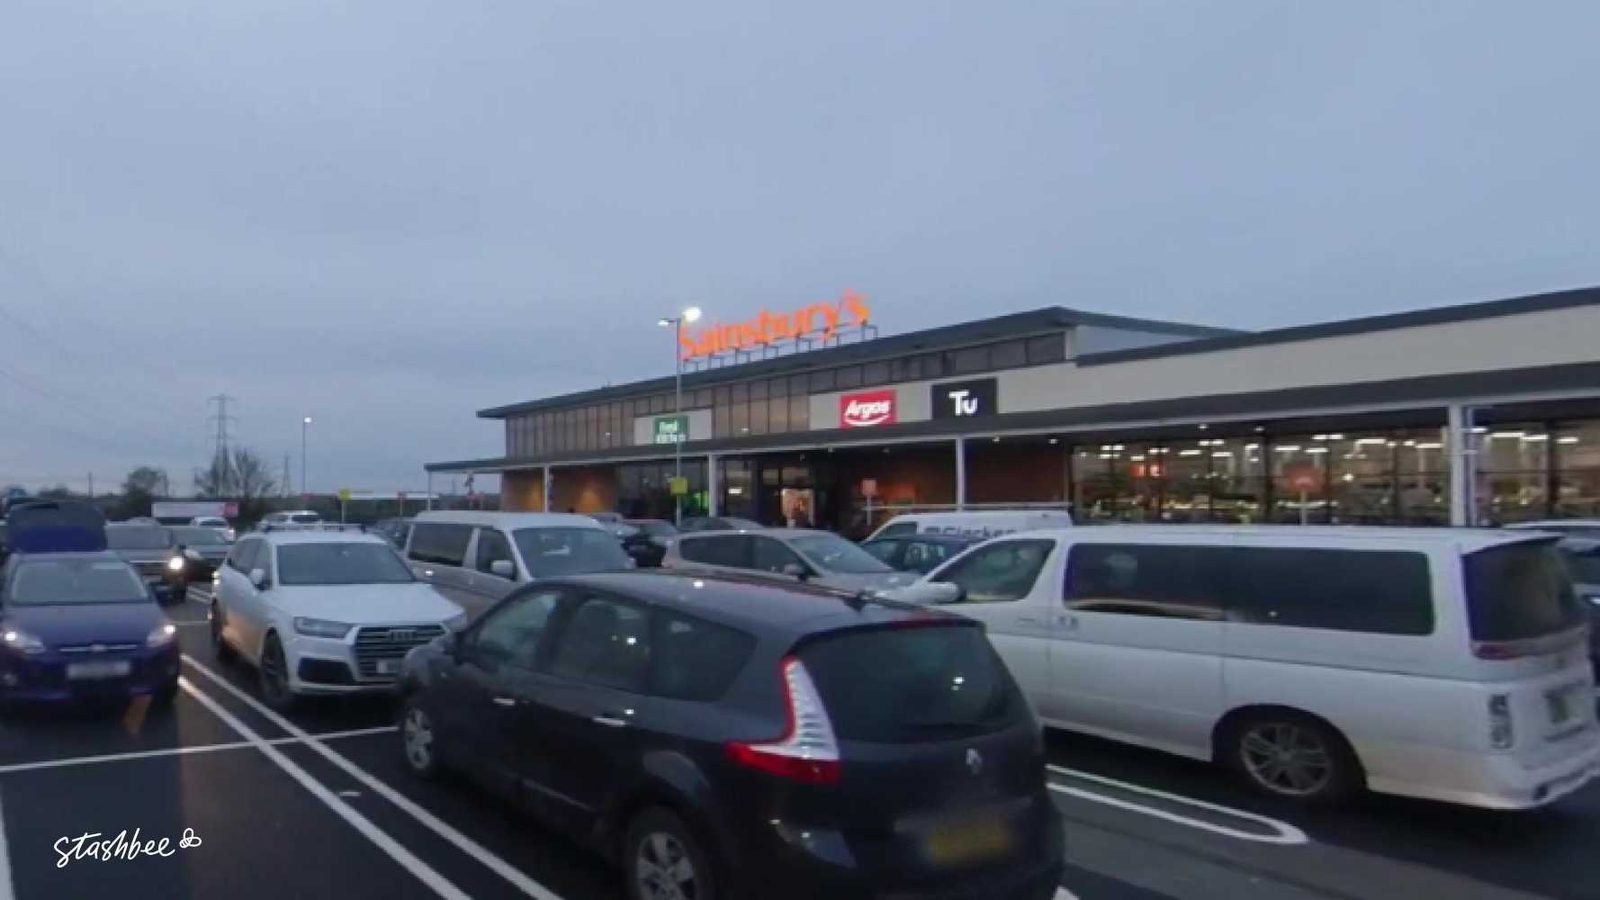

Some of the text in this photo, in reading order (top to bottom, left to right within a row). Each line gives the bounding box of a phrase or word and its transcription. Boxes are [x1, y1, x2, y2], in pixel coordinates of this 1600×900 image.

[679, 288, 870, 360] Sainsbury's
[844, 400, 892, 418] Argos
[949, 390, 978, 416] Tu
